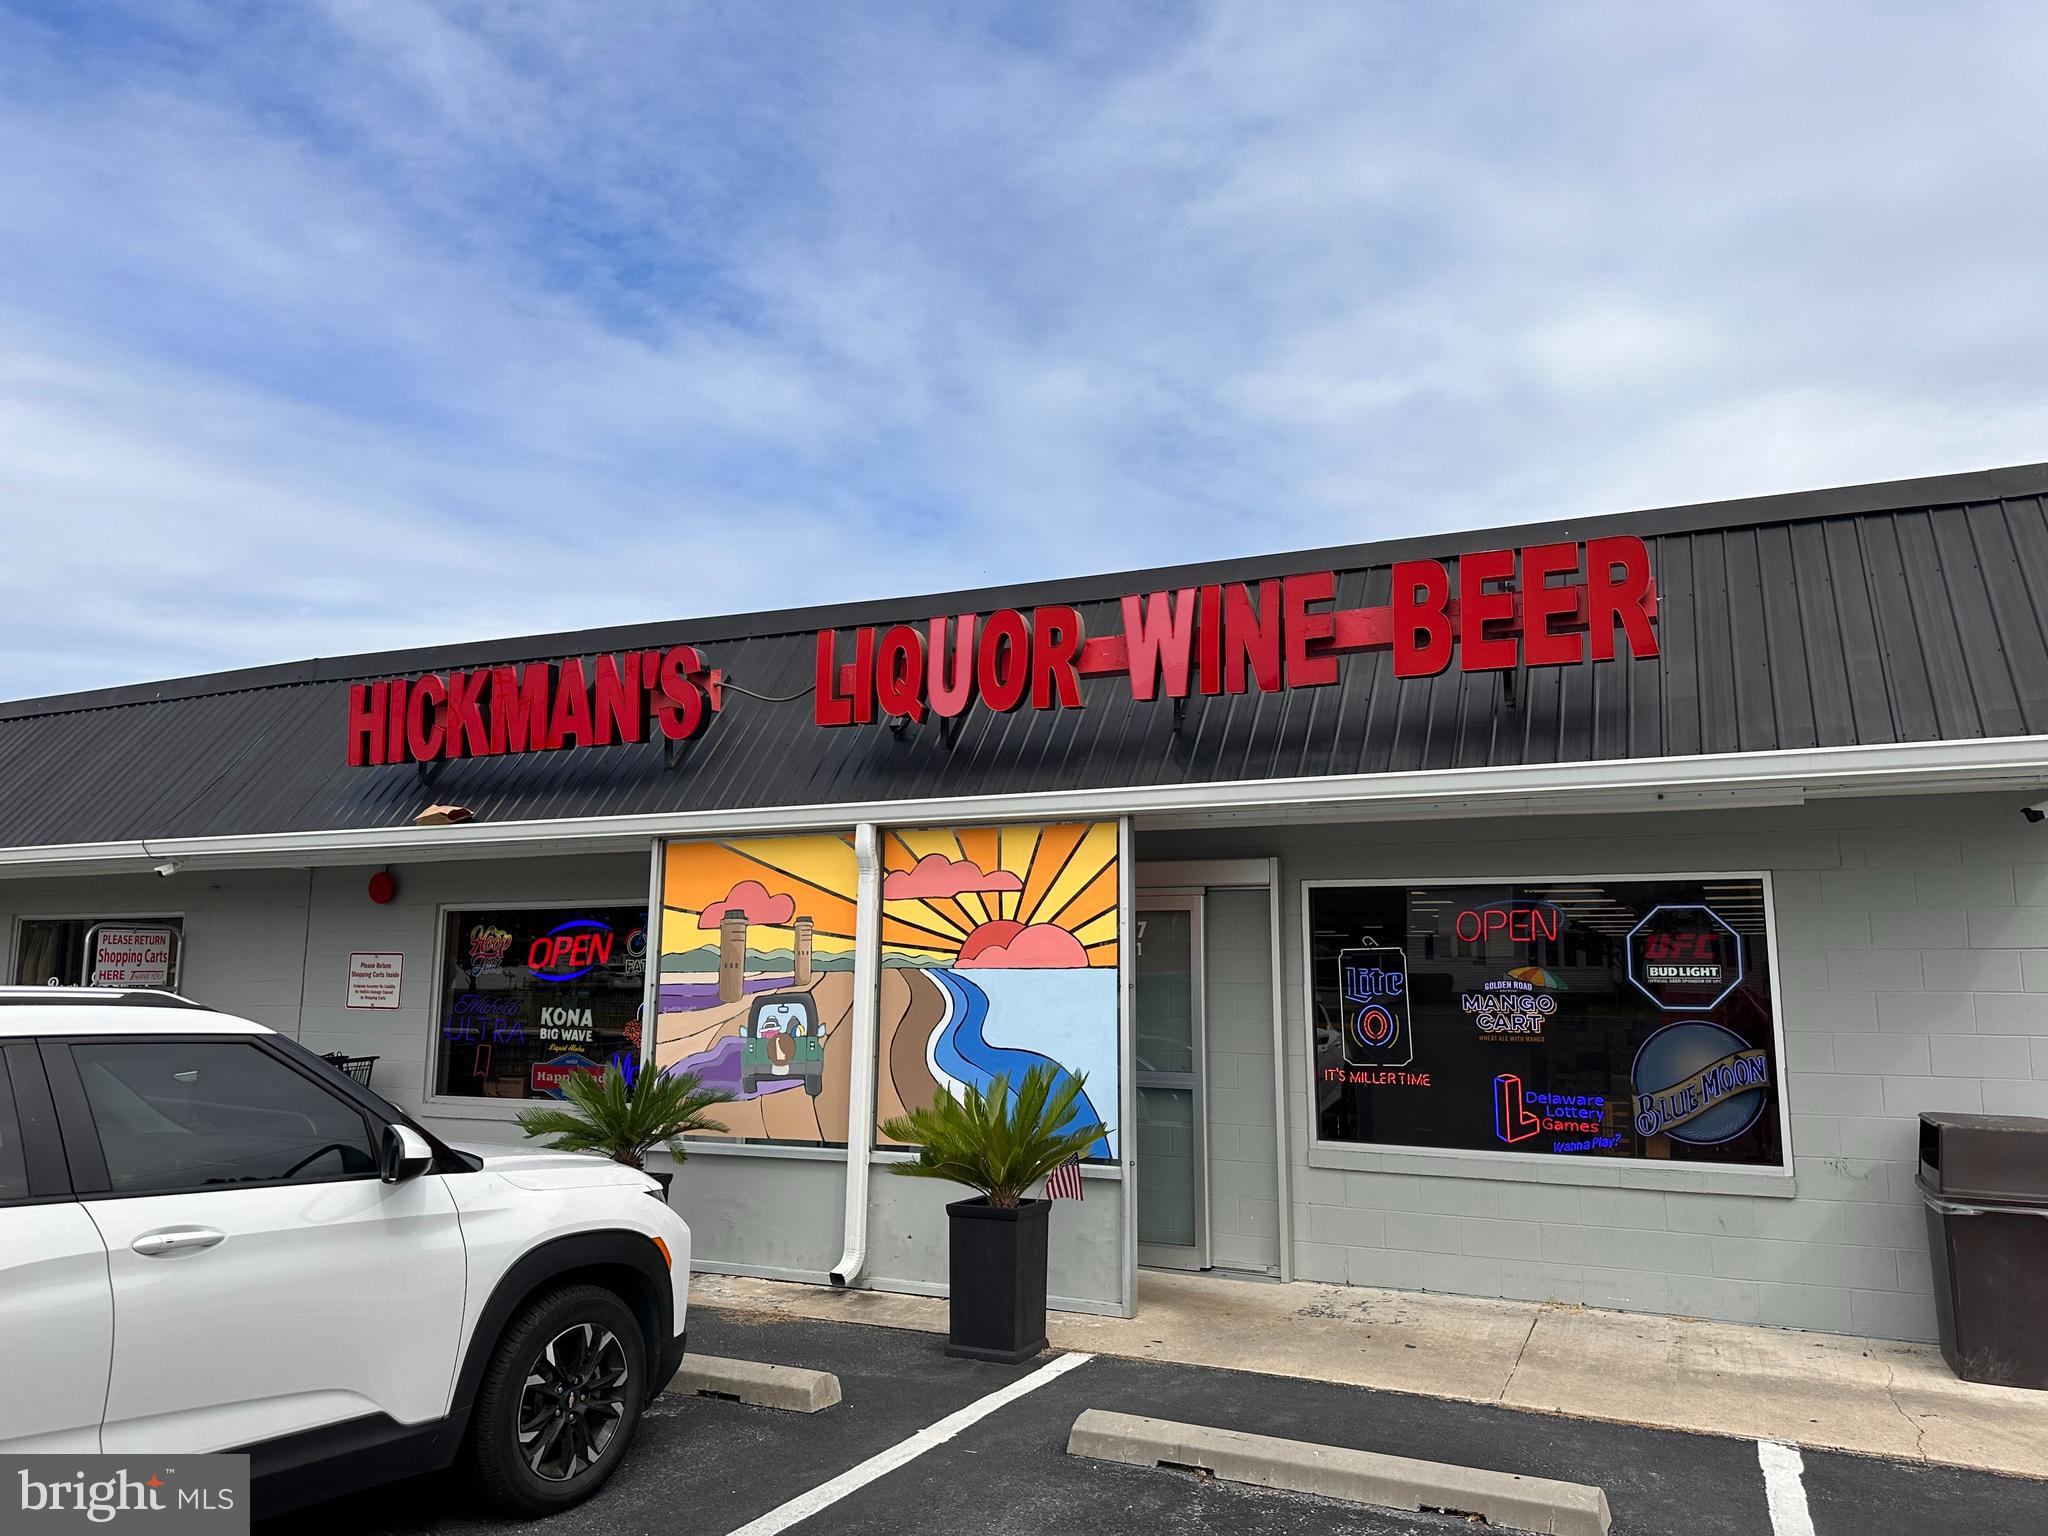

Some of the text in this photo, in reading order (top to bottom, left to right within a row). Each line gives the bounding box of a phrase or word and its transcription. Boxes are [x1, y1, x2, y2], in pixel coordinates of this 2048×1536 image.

[347, 535, 1661, 767] HICKMAN'S LIQUOR WINE BEER
[1457, 908, 1557, 943] OPEN
[103, 935, 166, 945] PLEASE RETURN
[1644, 933, 1720, 959] UFC
[98, 948, 168, 967] Shopping Carts
[528, 932, 615, 969] OPEN
[98, 970, 125, 980] HERE
[1650, 967, 1719, 977] BUD LIGHT
[1345, 966, 1404, 1003] Lite
[1484, 981, 1533, 991] GOLDEN ROAD
[1462, 993, 1557, 1014] MANGO
[541, 1007, 593, 1027] KONA
[1476, 1014, 1545, 1033] CART
[447, 1015, 526, 1045] ULTRA
[540, 1028, 593, 1042] BIG WAVE
[537, 1071, 572, 1084] Happ
[1324, 1067, 1431, 1087] IT'S MILLER TIME
[1525, 1091, 1605, 1107] Delaware
[1635, 1055, 1768, 1137] BLUE MOON
[1546, 1105, 1604, 1123] Lottery
[1542, 1117, 1600, 1133] Games
[1553, 1133, 1622, 1153] Wanna Play?
